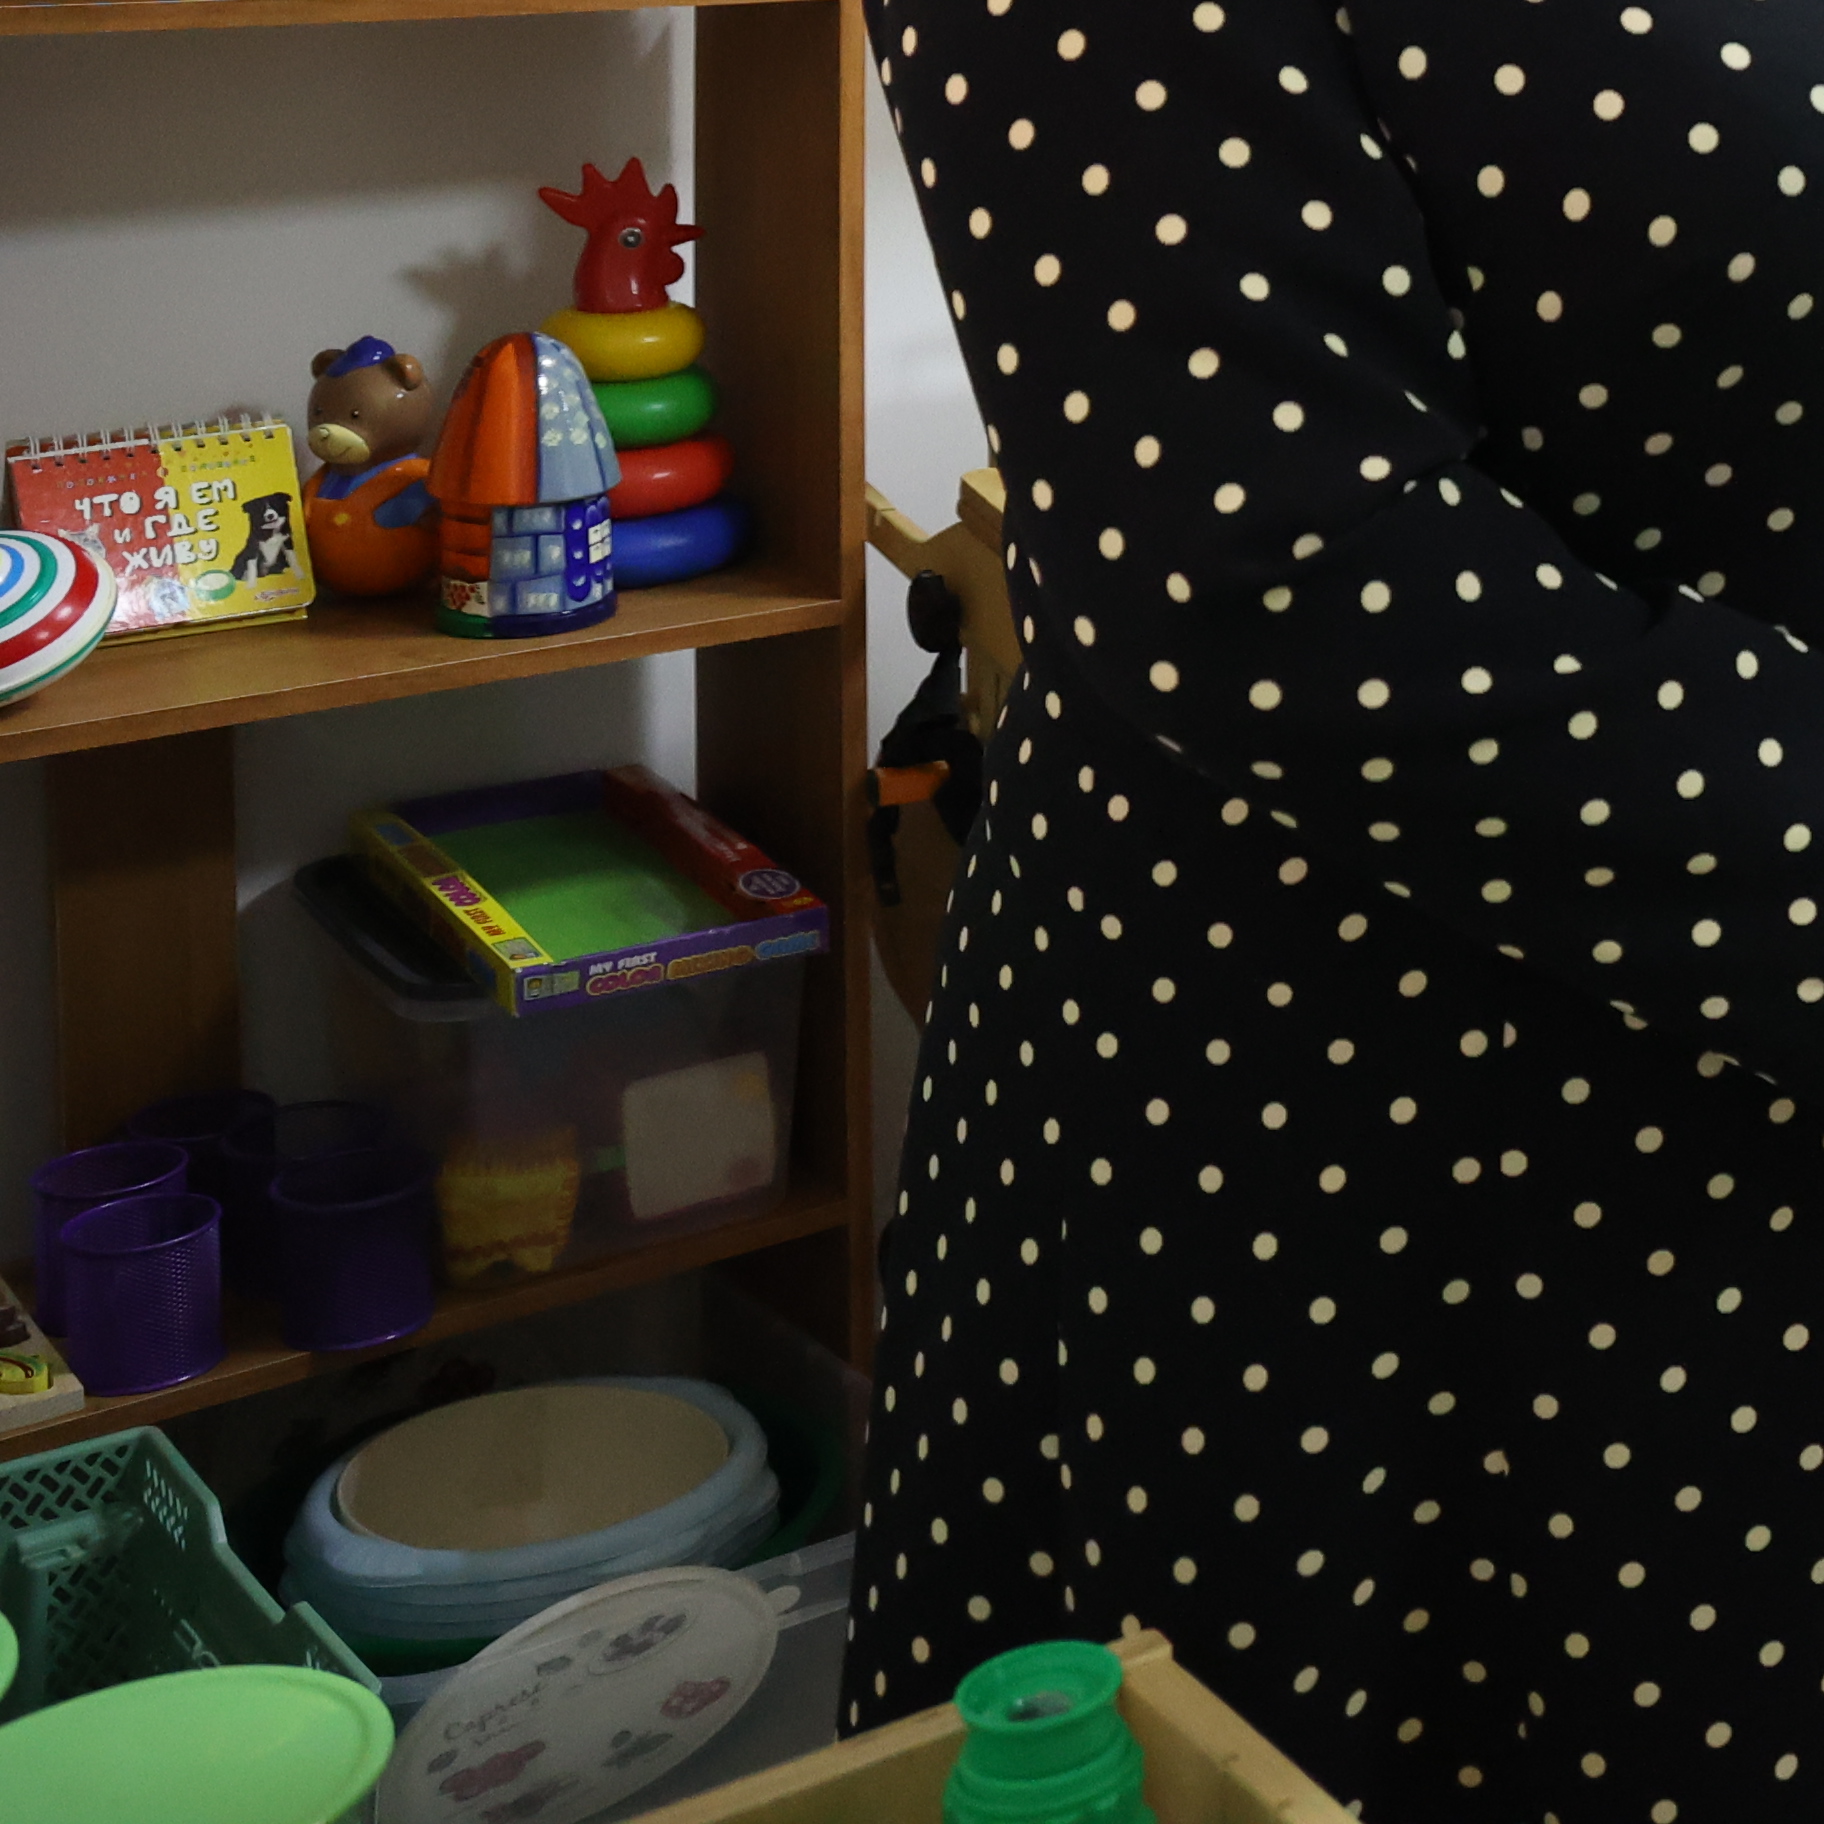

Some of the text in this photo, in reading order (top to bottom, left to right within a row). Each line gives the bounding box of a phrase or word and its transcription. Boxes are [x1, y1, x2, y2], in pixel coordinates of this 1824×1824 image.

[74, 477, 236, 520] ЧТО Я ЕМ
[144, 507, 219, 539] ГДЕ
[122, 537, 218, 577] ЖИВУ
